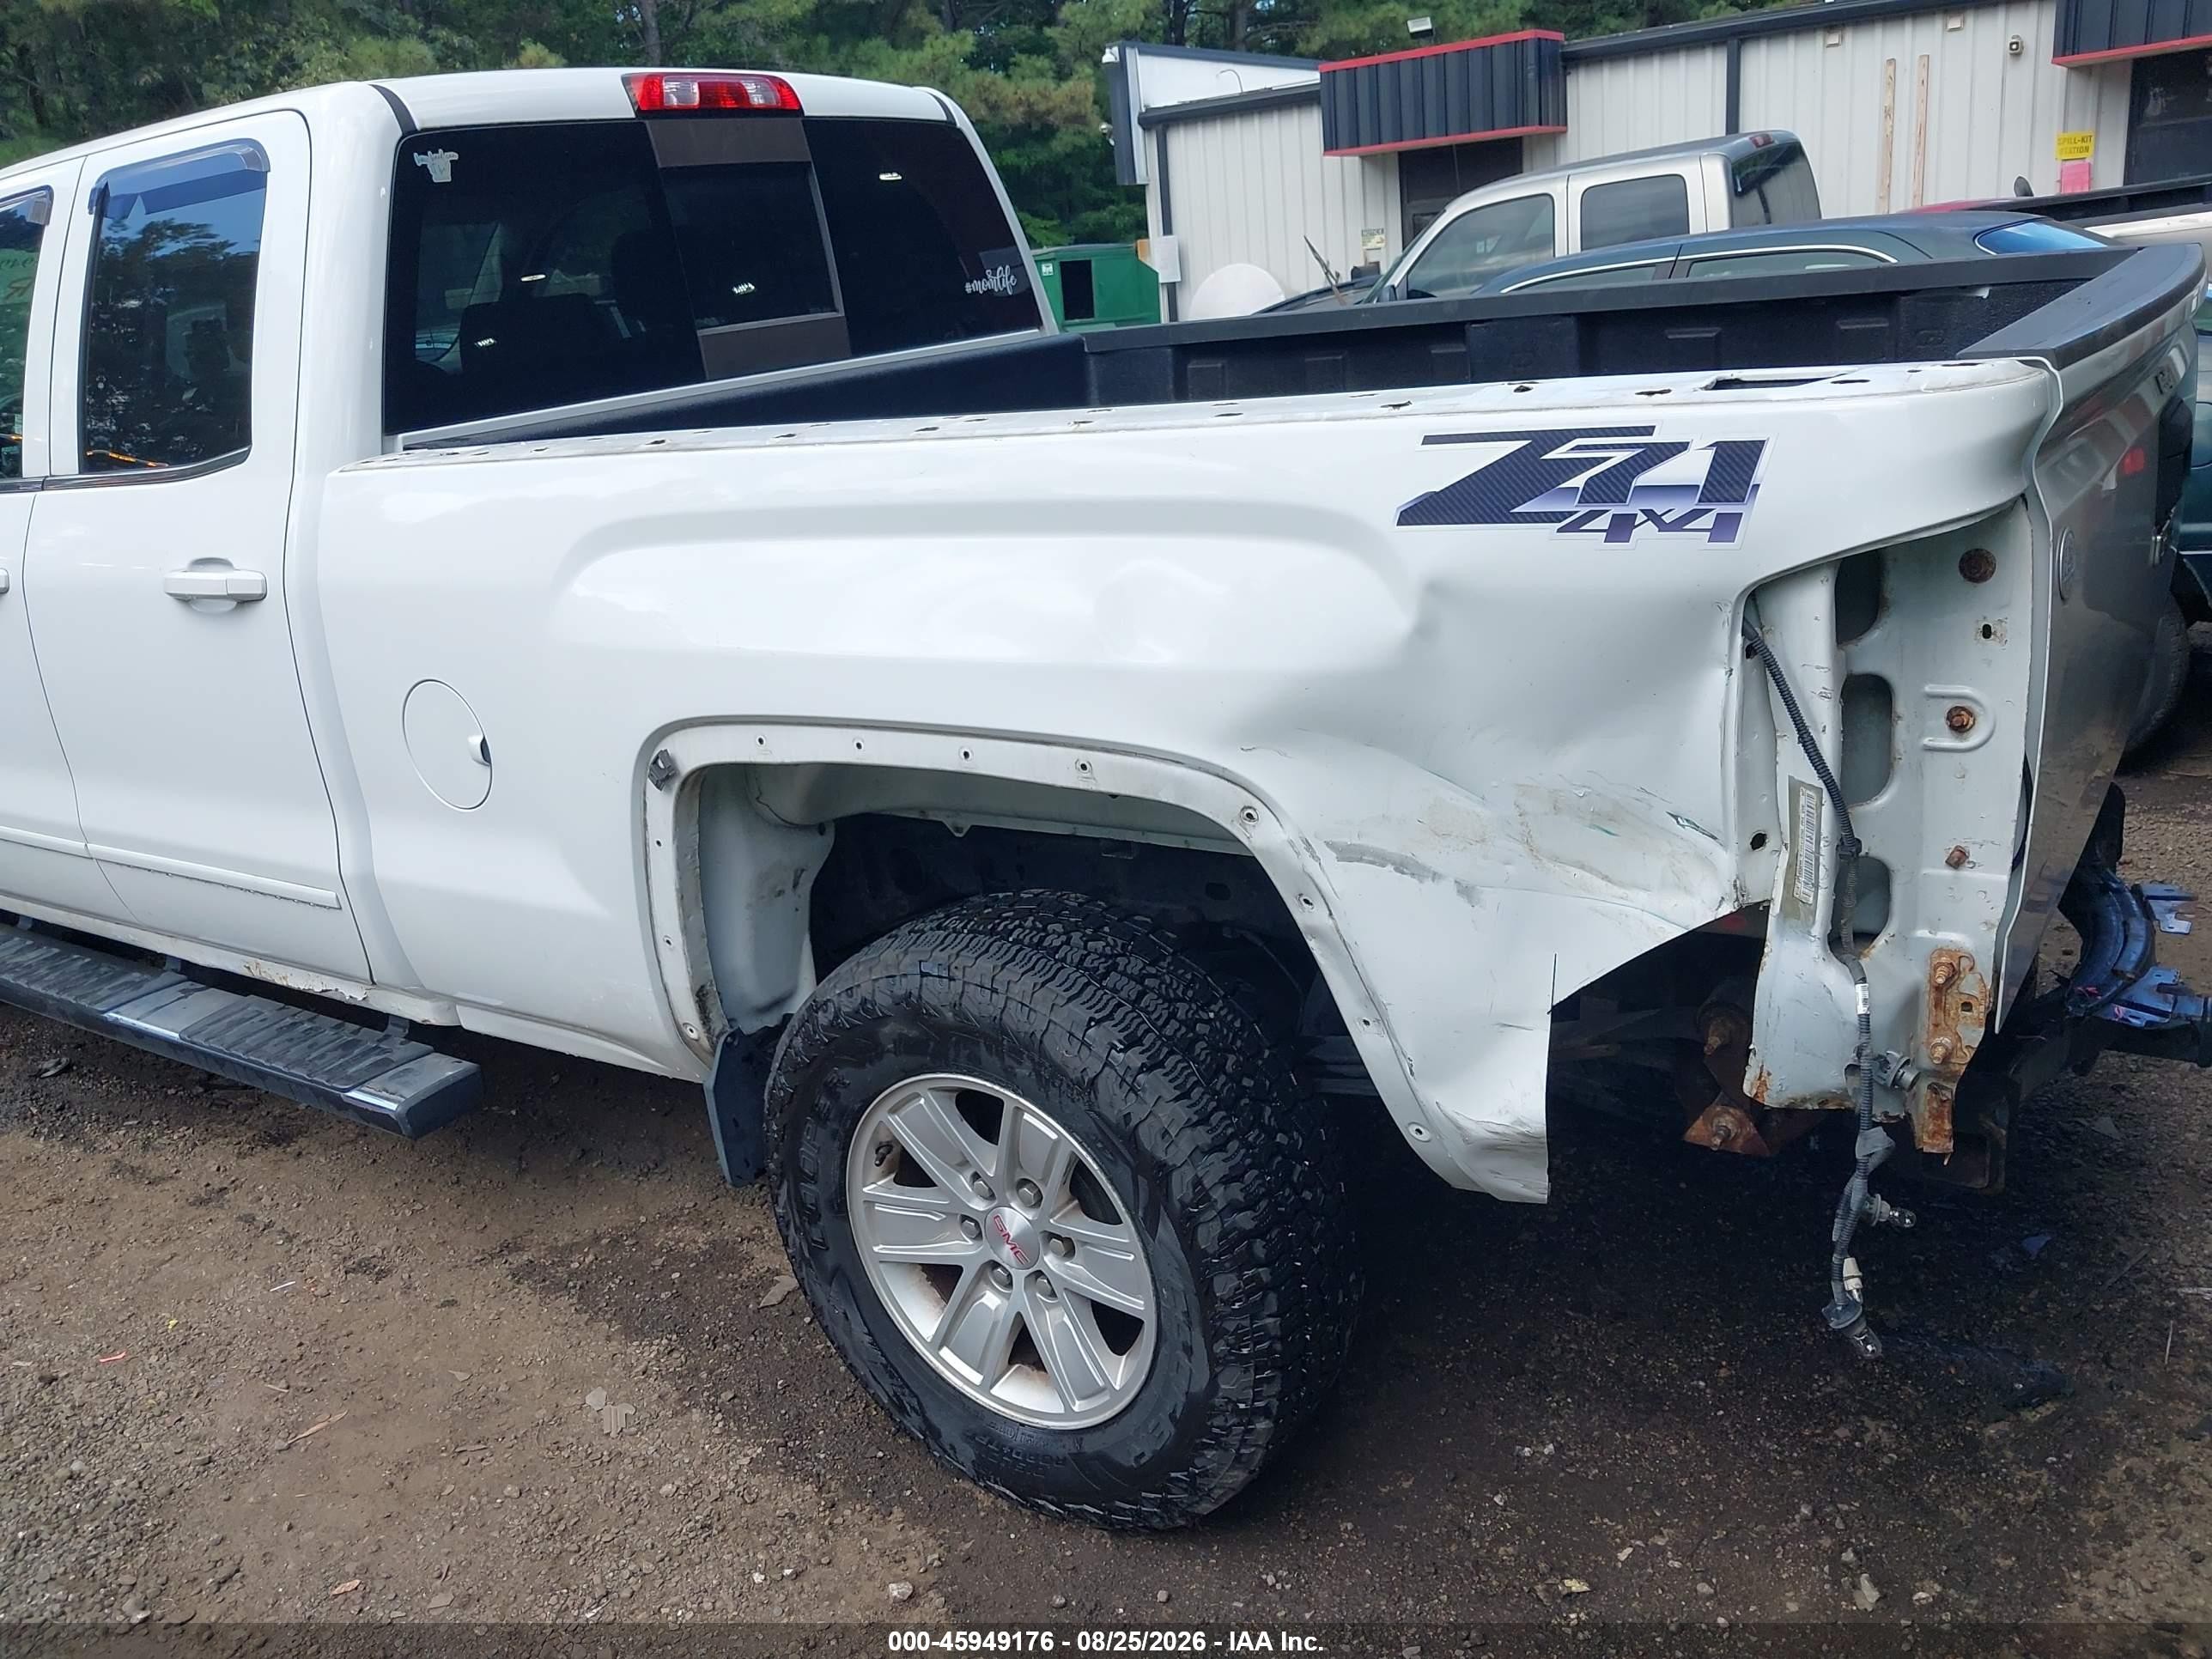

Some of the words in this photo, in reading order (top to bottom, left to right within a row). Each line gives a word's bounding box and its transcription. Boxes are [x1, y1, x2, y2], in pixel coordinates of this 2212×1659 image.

[964, 265, 1018, 295] #momlife
[1396, 425, 1767, 526] Z71
[993, 1213, 1030, 1266] GMC
